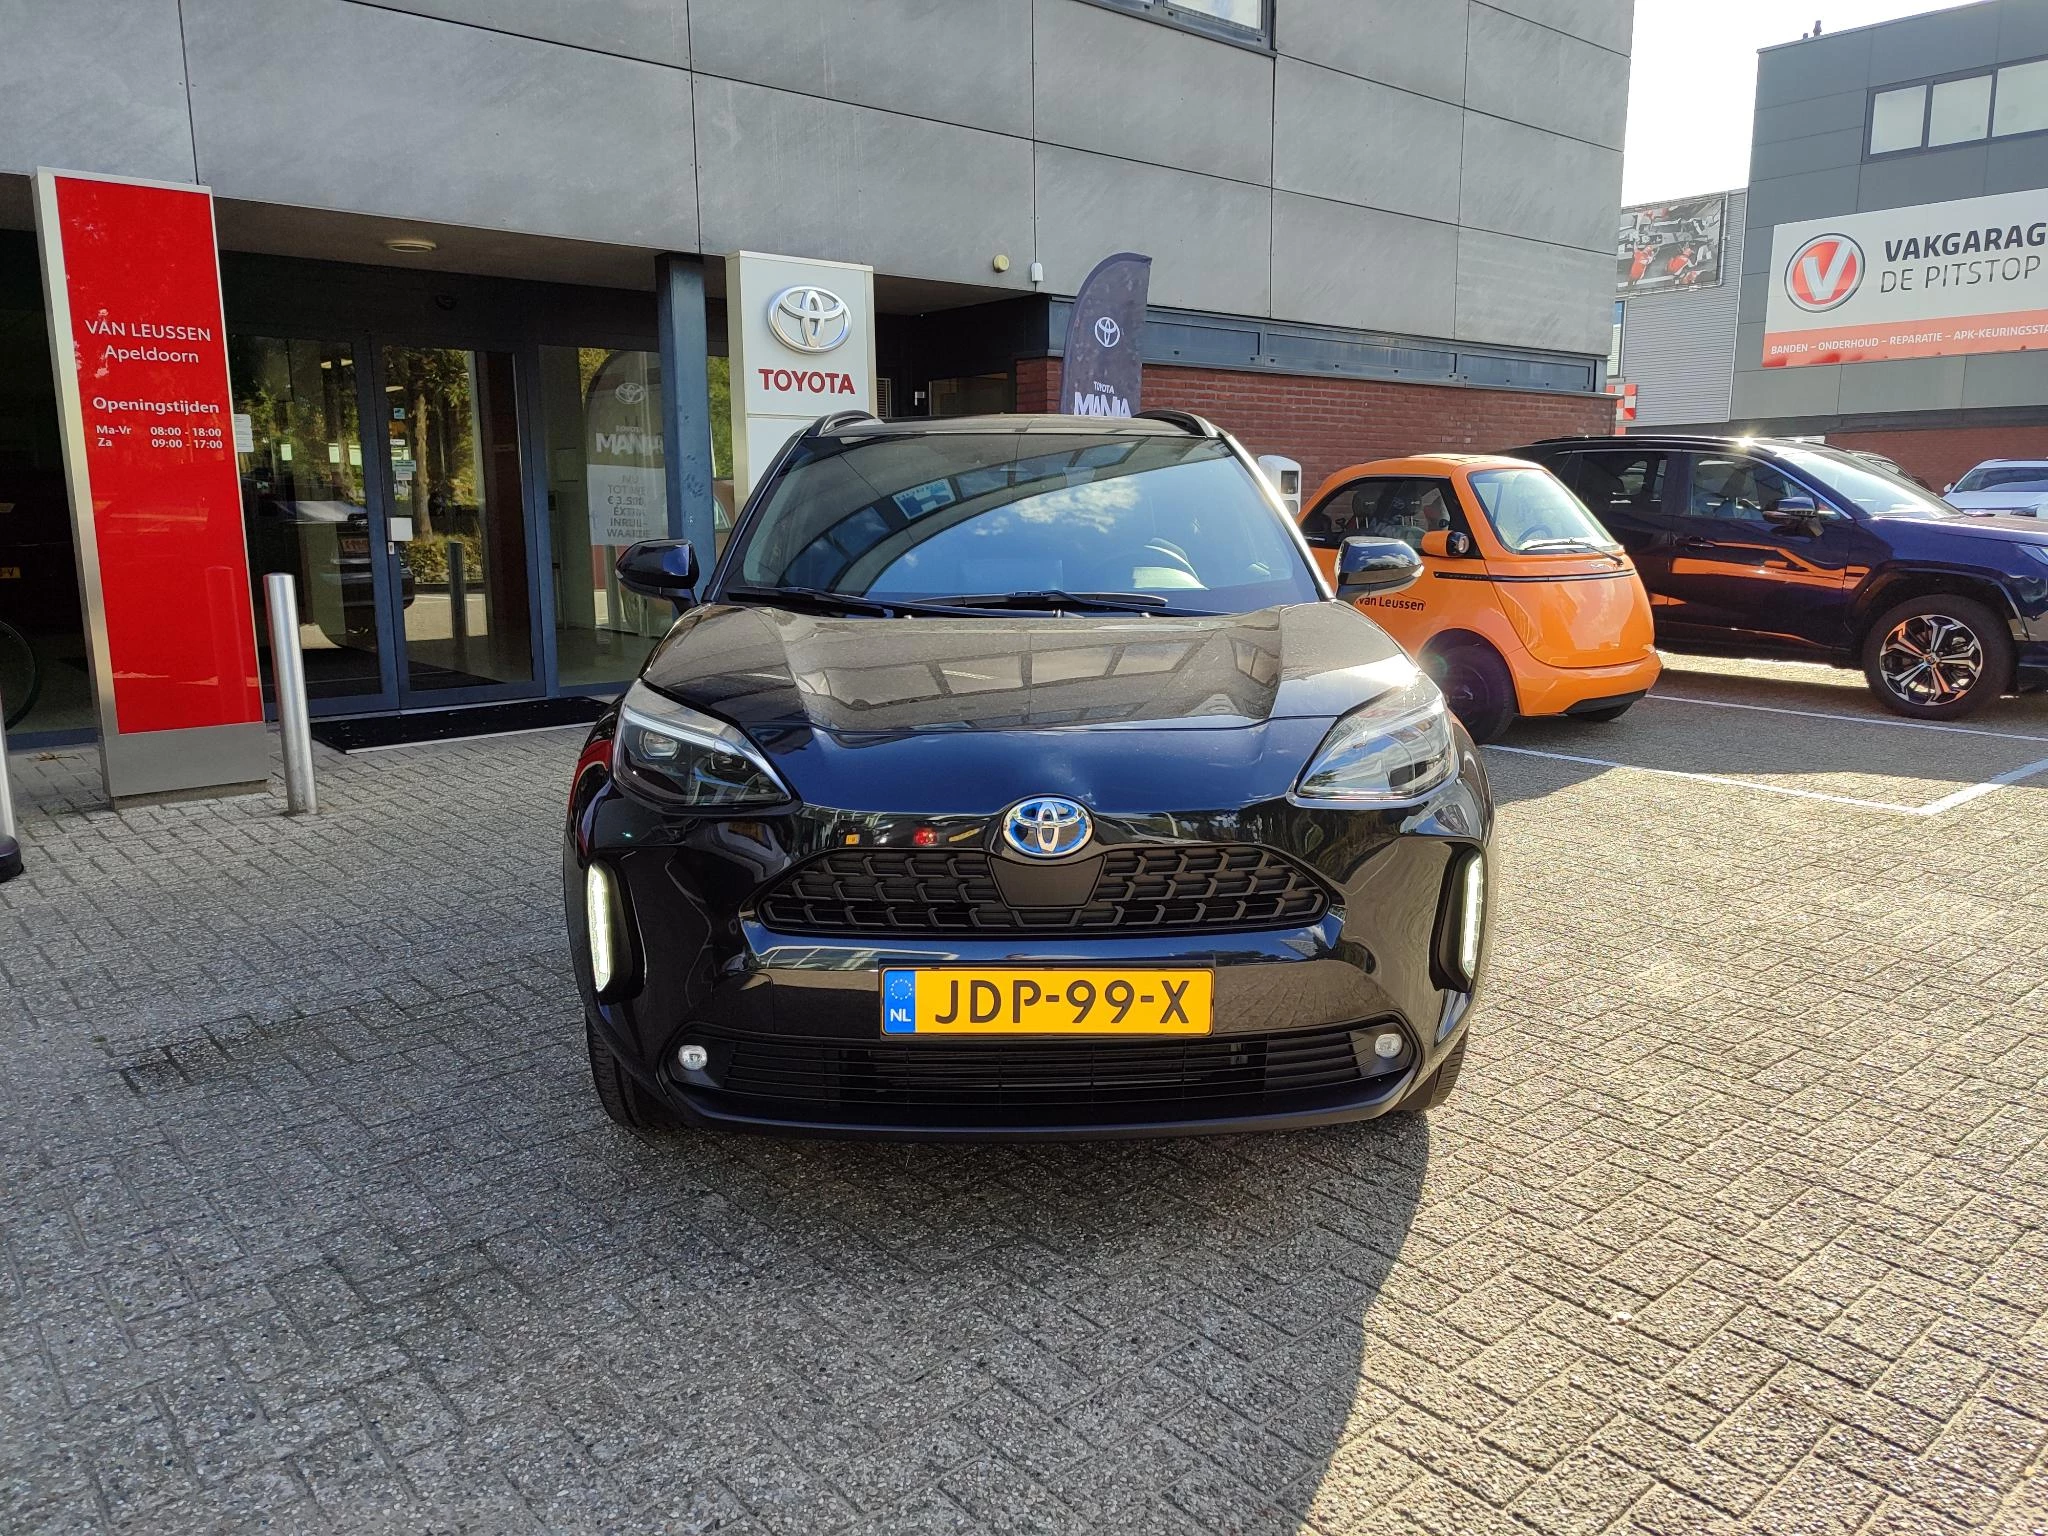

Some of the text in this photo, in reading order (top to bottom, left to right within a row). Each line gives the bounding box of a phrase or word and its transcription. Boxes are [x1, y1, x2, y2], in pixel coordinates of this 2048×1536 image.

[1885, 222, 2047, 262] VAKGARAG
[1881, 255, 2041, 293] DE PITSTOP
[84, 319, 211, 342] VAN LEUSSEN
[104, 344, 200, 364] Apeldoorn
[1770, 342, 1808, 355] BANDEN
[1818, 337, 1879, 352] ONDERHOUD
[1889, 331, 1943, 346] REPARATIE
[758, 368, 856, 395] TOYOTA
[1093, 381, 1115, 394] TOYOTA
[92, 396, 220, 416] Openingstijden
[1074, 392, 1132, 418] MANIA
[96, 424, 132, 436] Ma-Vr
[150, 427, 182, 437] 08:00
[192, 427, 222, 438] 18:00
[97, 437, 113, 448] Za
[151, 438, 183, 449] 09:00
[194, 439, 223, 449] 17:00
[1379, 597, 1425, 611] Leussen
[890, 979, 1190, 1024] NL JDP-99-X
